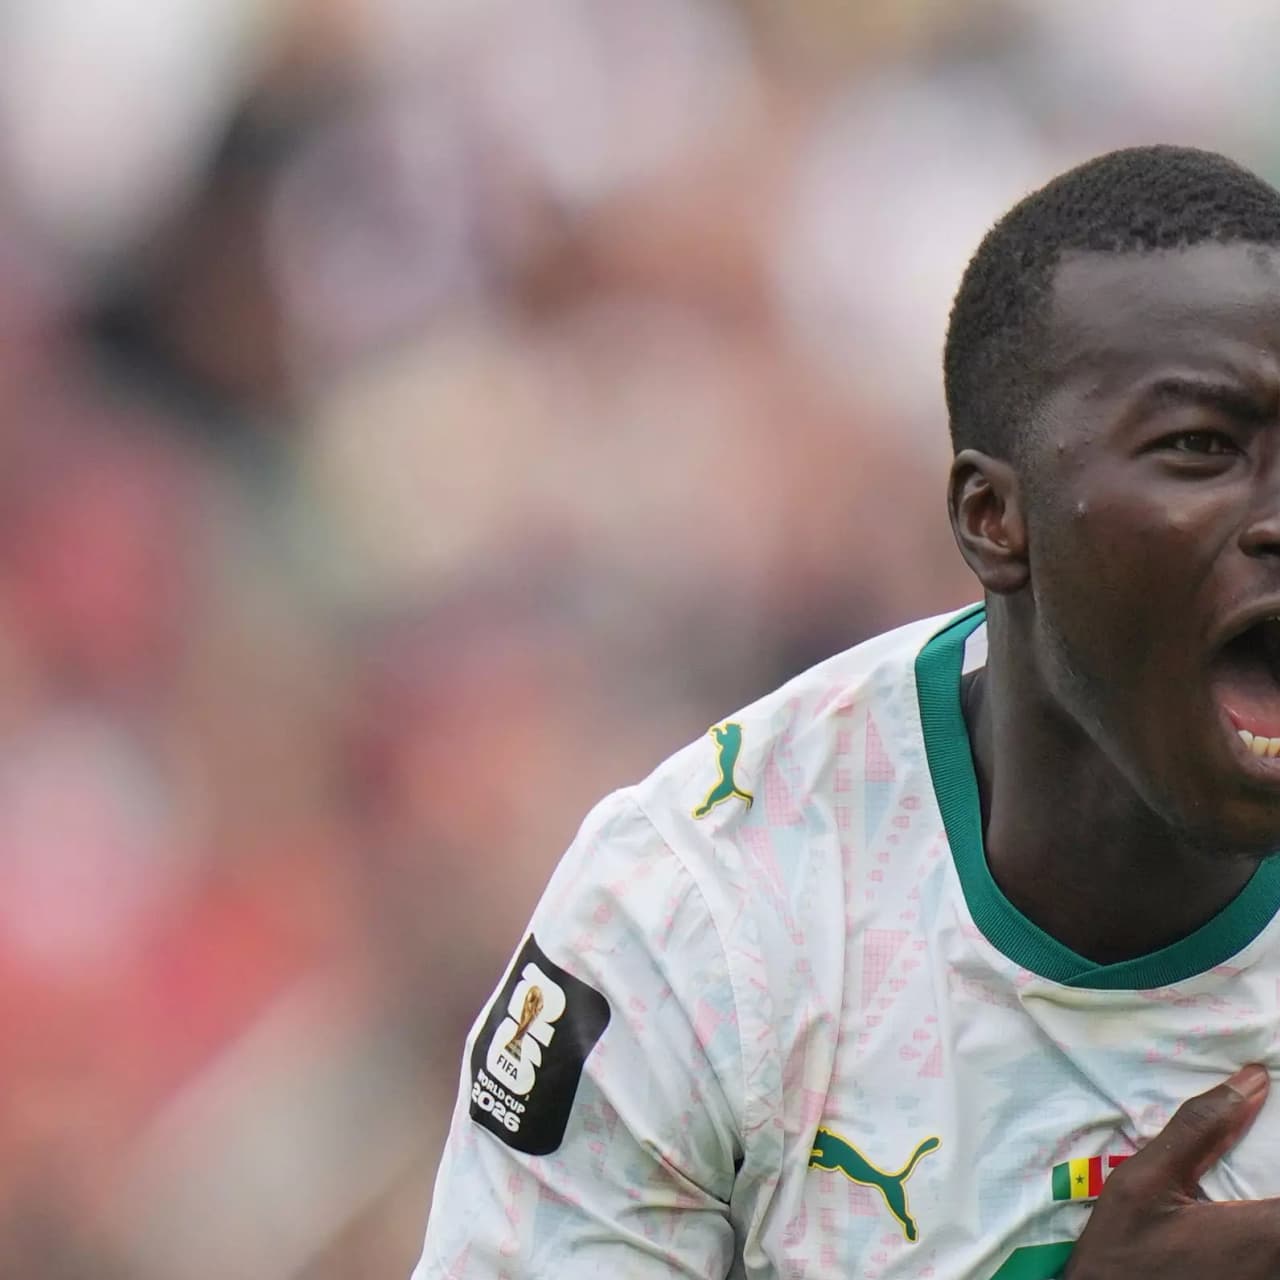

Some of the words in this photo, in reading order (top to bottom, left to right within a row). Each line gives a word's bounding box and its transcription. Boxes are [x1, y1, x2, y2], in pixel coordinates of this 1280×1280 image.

[496, 1054, 519, 1080] FIFA
[471, 1082, 521, 1132] 2026
[477, 1068, 506, 1100] WORLD
[504, 1094, 526, 1114] CUP
